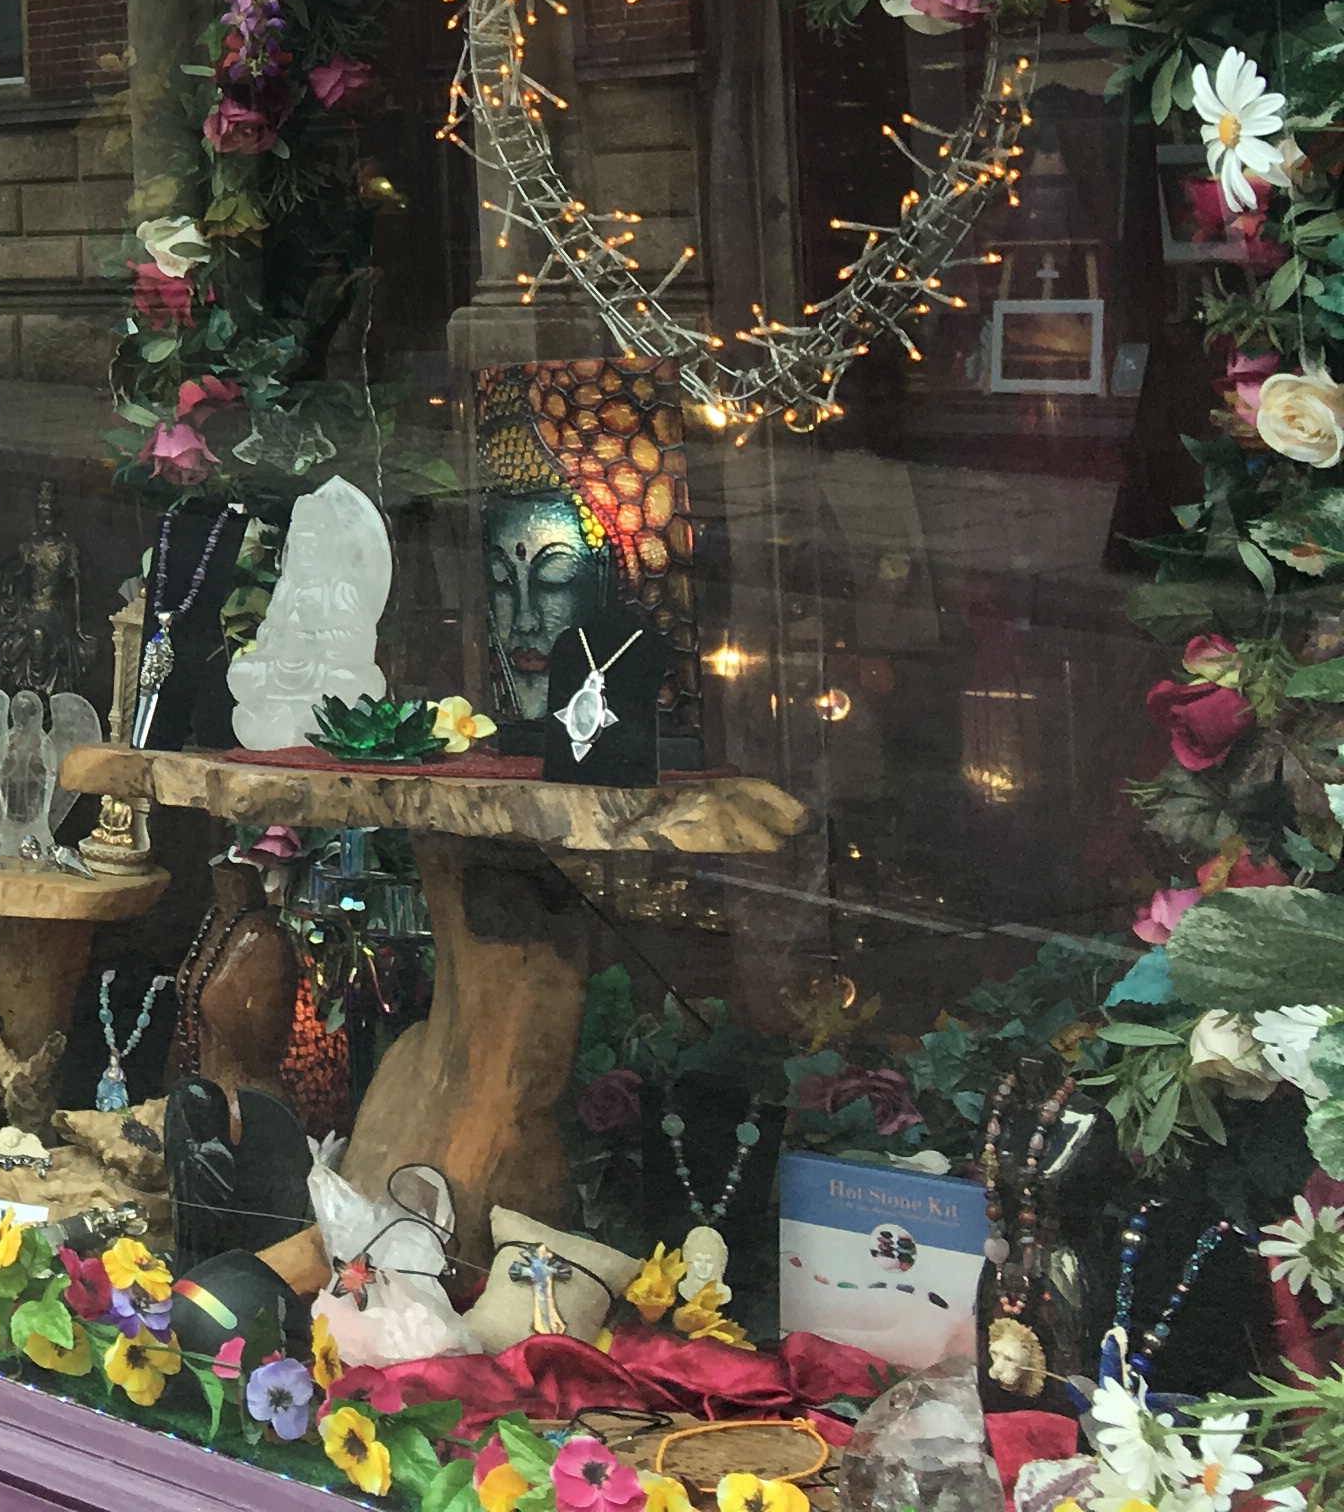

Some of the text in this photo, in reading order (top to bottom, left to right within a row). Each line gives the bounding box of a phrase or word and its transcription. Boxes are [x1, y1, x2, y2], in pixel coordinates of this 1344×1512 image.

[829, 1178, 862, 1200] Hot
[868, 1188, 923, 1211] Stone
[928, 1196, 958, 1219] Kit
